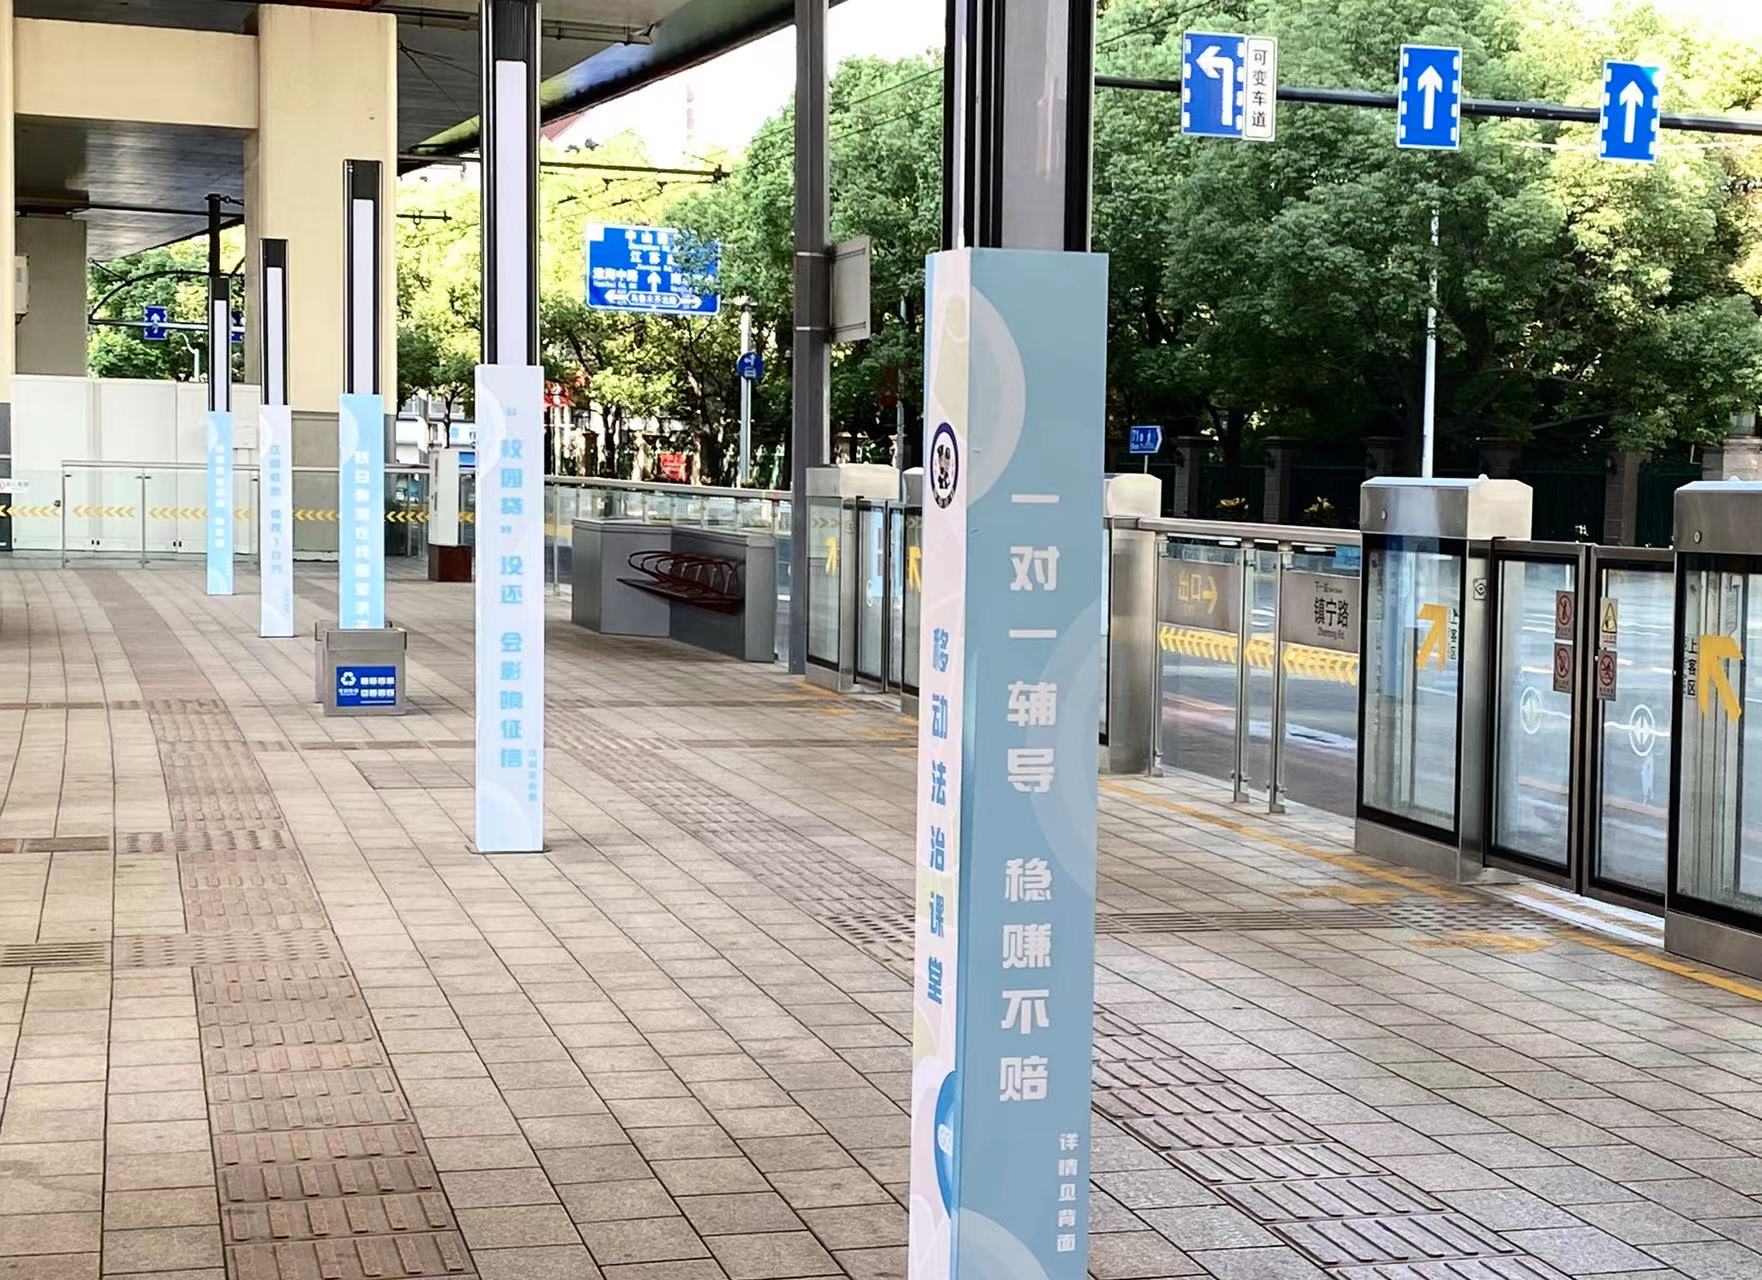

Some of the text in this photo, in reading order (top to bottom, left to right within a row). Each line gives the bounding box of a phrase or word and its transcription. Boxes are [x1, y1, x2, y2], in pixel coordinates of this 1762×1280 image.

[1252, 49, 1268, 128] 可变车道
[1178, 573, 1202, 602] 出口
[1314, 597, 1349, 629] 镇宁路
[501, 632, 523, 768] 会影响征信
[1687, 637, 1698, 696] 上客区
[927, 627, 950, 1005] 移动法治课堂
[1000, 493, 1060, 1101] 一对一辅导 稳赚不赔
[1056, 1132, 1080, 1253] 详情见背面
